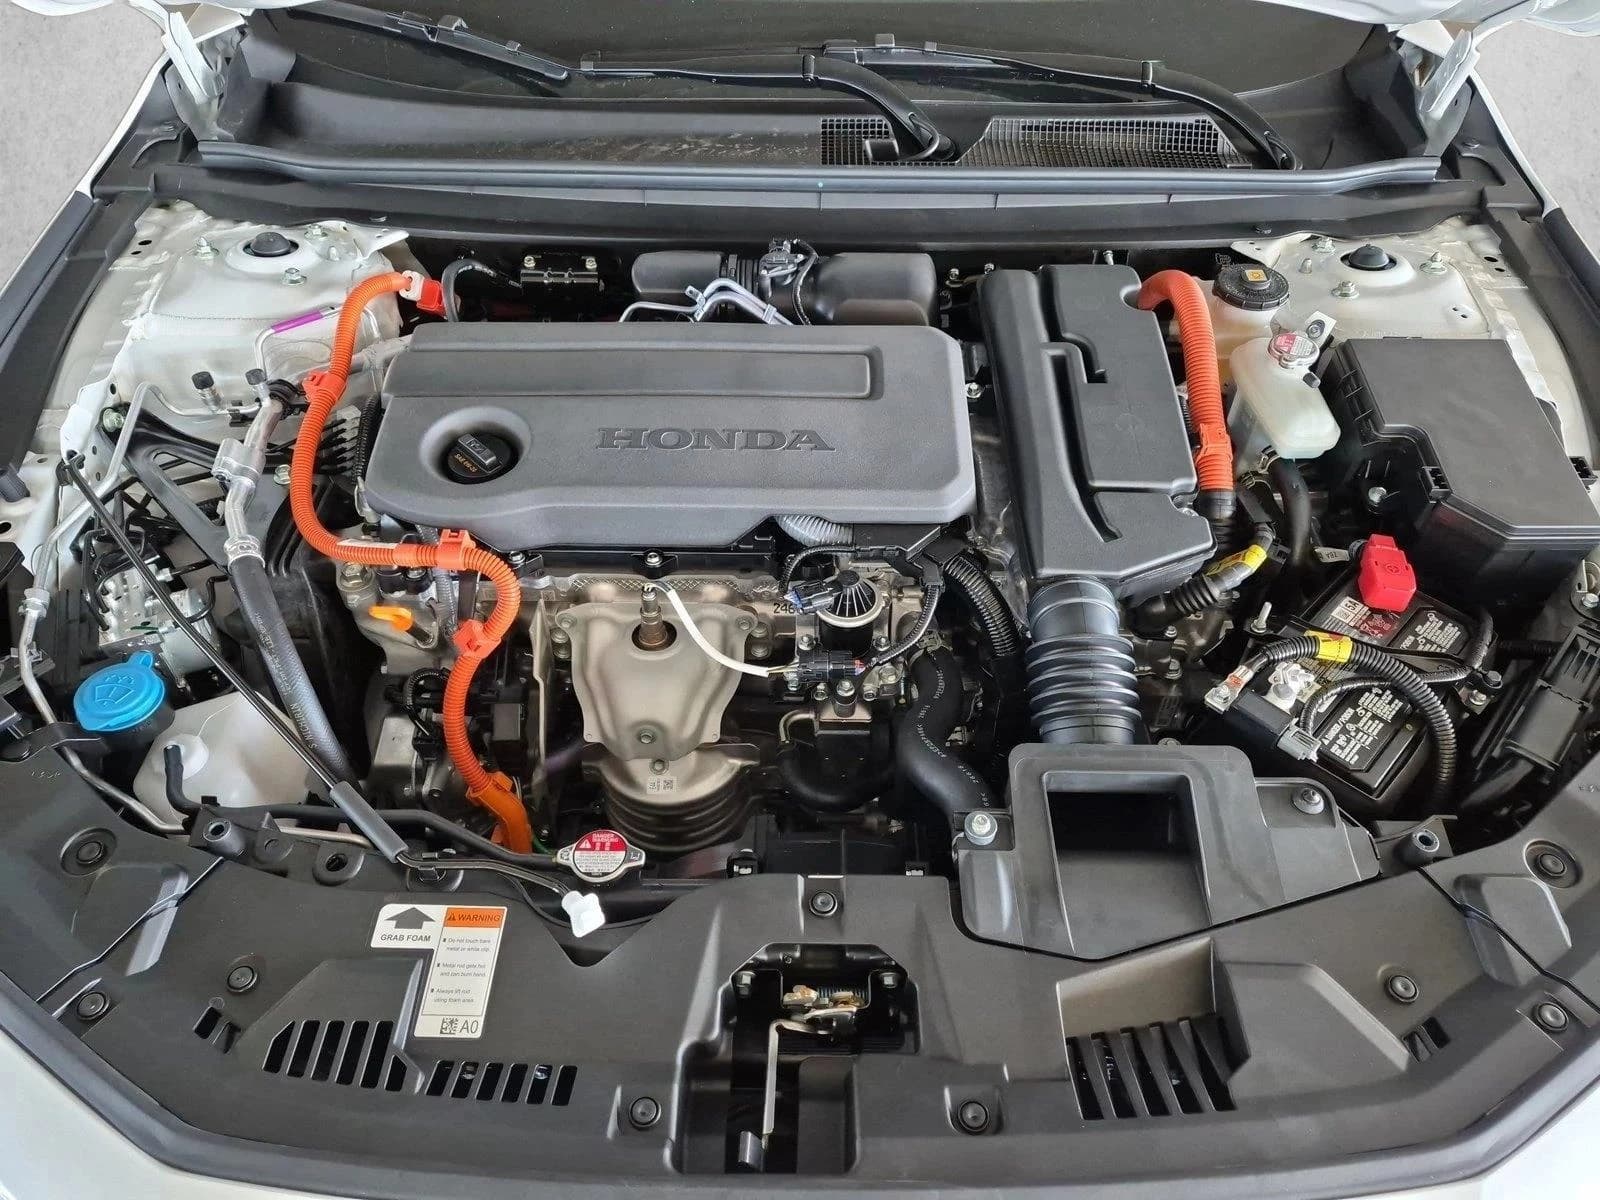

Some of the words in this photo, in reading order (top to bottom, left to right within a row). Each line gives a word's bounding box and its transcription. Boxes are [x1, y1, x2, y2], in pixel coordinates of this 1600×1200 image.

[597, 427, 836, 452] HONDA
[457, 913, 502, 922] WARNING
[380, 933, 405, 942] GRAB
[406, 934, 432, 942] FOAM
[459, 1019, 479, 1034] A0
